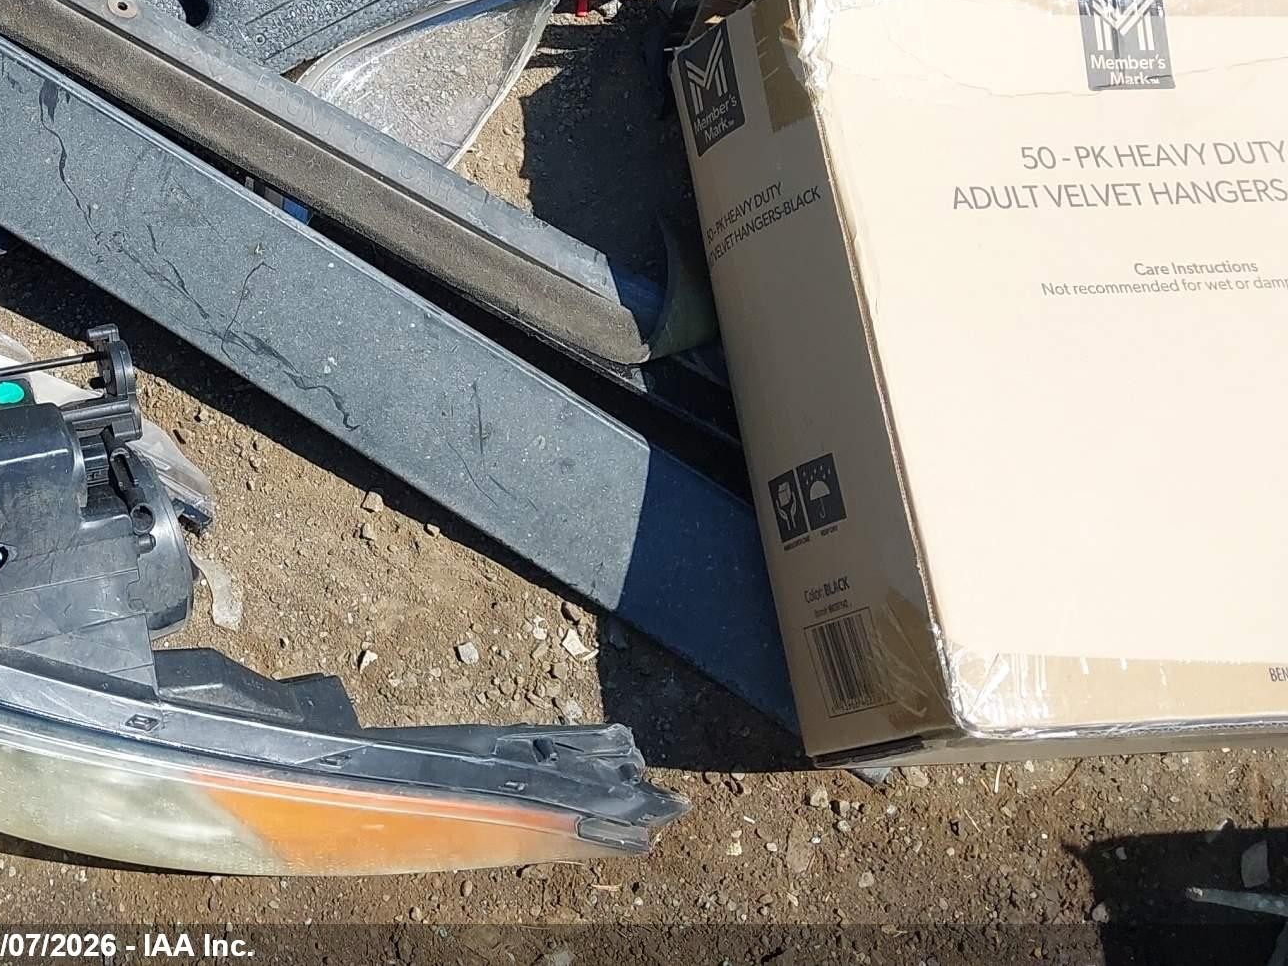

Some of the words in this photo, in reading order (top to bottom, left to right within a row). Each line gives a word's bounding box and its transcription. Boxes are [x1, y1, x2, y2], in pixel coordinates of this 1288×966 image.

[1090, 54, 1166, 70] Member's
[694, 94, 737, 135] Member's
[1113, 142, 1205, 167] HEAVY
[1213, 140, 1285, 164] DUTY
[724, 197, 753, 226] HEAVY
[753, 181, 782, 208] DUTY
[953, 186, 1038, 209] ADULT
[1043, 183, 1142, 208] VELVET
[1148, 178, 1288, 205] HANGERS
[1134, 262, 1170, 276] Care
[1171, 260, 1258, 275] Instructions
[1041, 282, 1071, 296] Not
[1072, 279, 1180, 294] recommended
[1182, 278, 1202, 291] for
[1206, 279, 1233, 290] wet
[1235, 280, 1250, 290] or
[824, 576, 850, 596] BLACK
